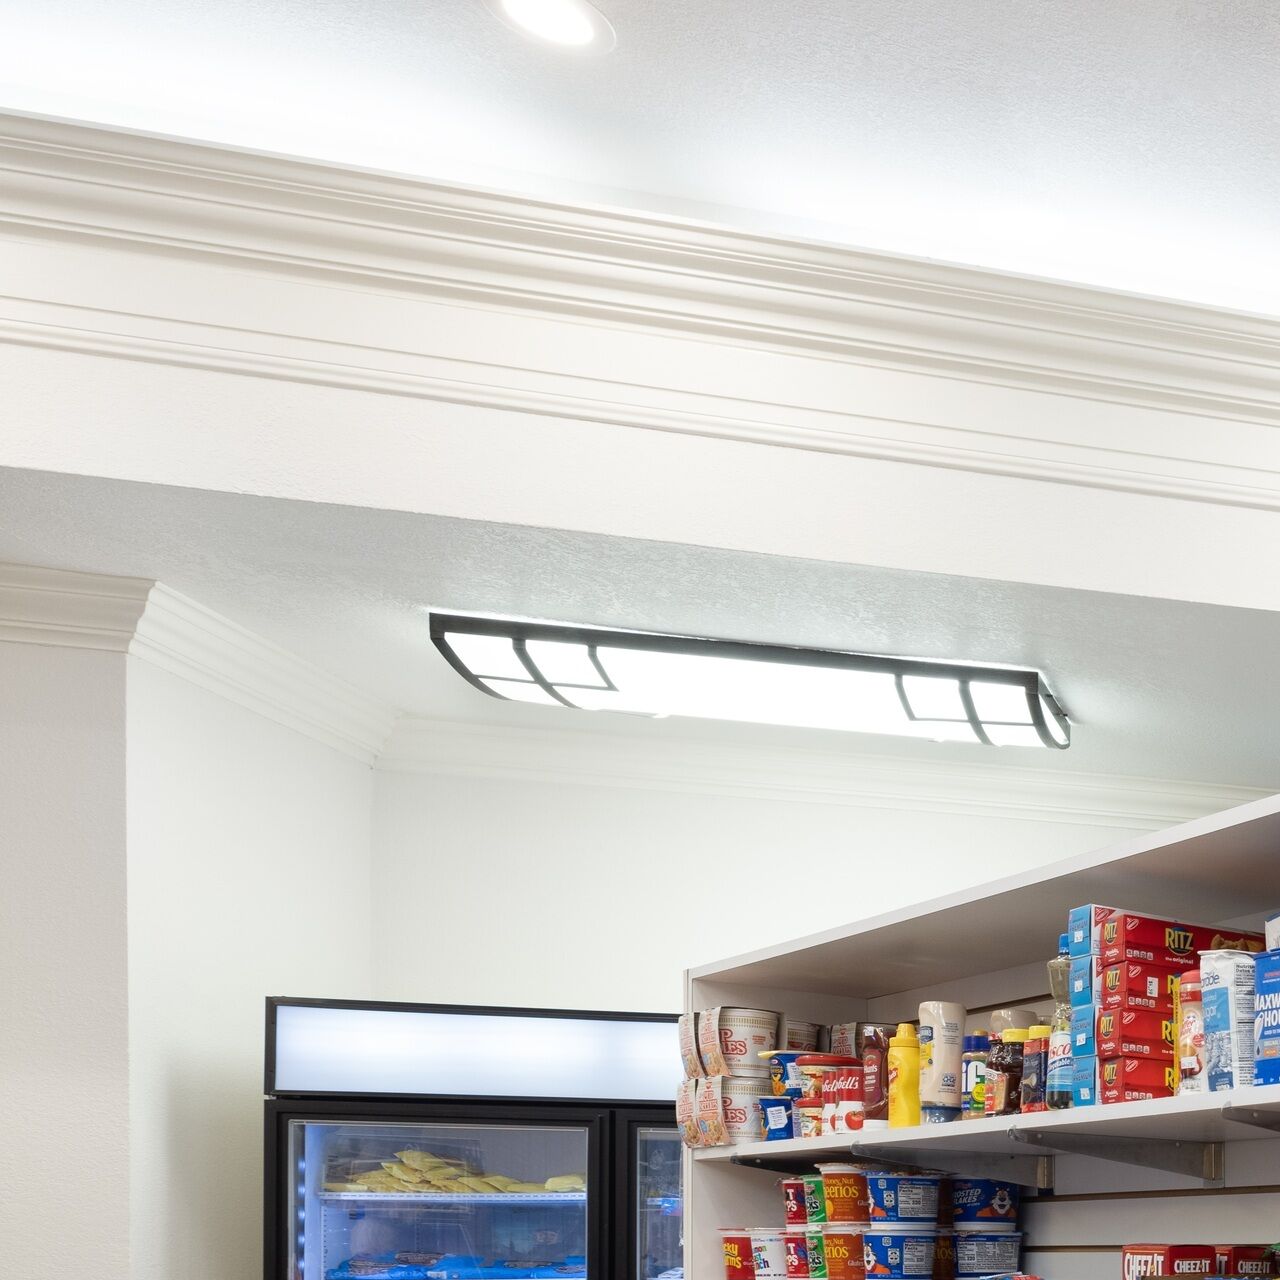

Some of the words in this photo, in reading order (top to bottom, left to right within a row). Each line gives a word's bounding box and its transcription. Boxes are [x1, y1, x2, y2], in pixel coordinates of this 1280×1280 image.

[1104, 922, 1117, 940] RITZ
[1165, 926, 1194, 951] RITZ
[1172, 956, 1194, 965] original
[1106, 970, 1120, 987] RITZ
[1101, 1016, 1114, 1034] RITZ
[1104, 1063, 1117, 1081] RITZ
